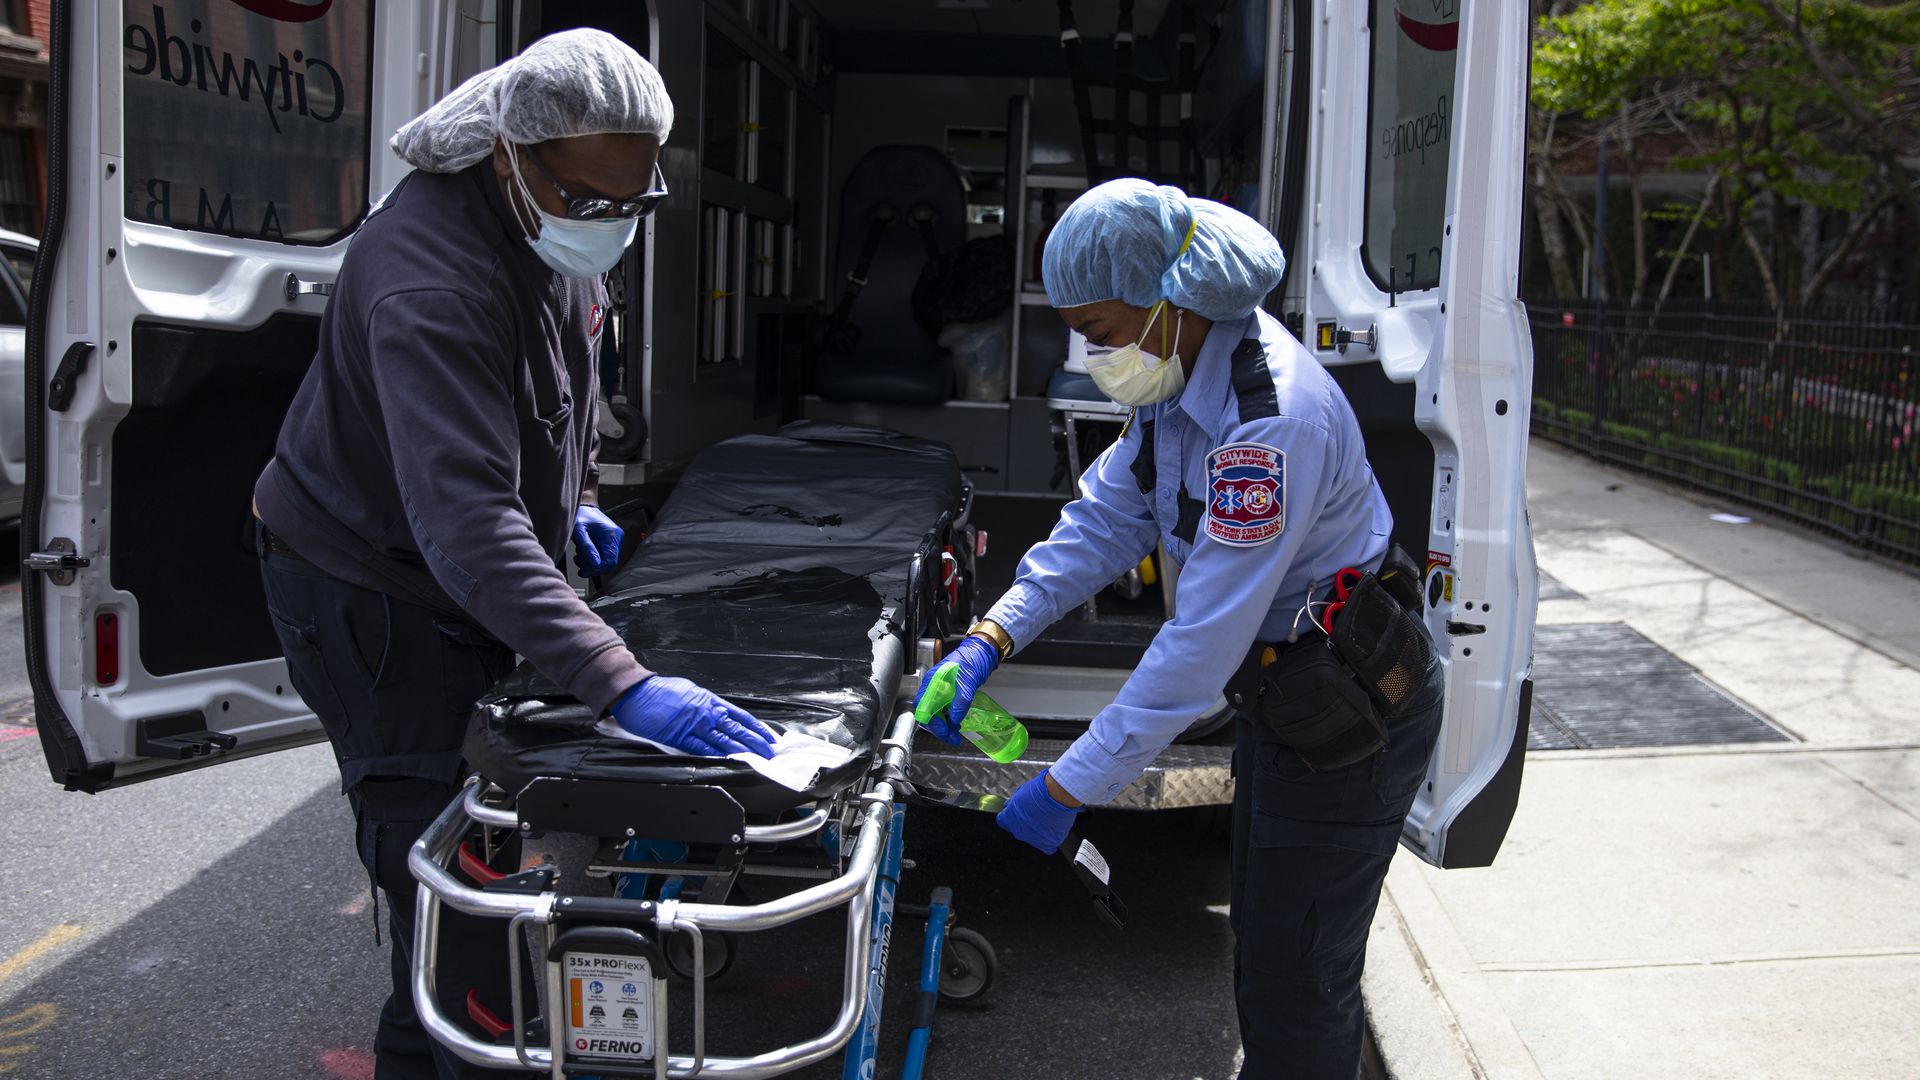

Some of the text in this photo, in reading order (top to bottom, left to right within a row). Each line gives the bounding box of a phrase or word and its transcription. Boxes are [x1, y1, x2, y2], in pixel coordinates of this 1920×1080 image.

[1219, 449, 1269, 462] CITYWIDE
[1215, 458, 1275, 470] MOBILE RESPONSE
[1210, 520, 1223, 532] NEW
[1224, 526, 1240, 535] YORK
[1241, 526, 1262, 535] STATE
[1210, 525, 1281, 540] CERTIFIED AMBULANCE
[569, 957, 646, 971] 35x PROFlexx
[589, 1039, 642, 1054] FERNO
